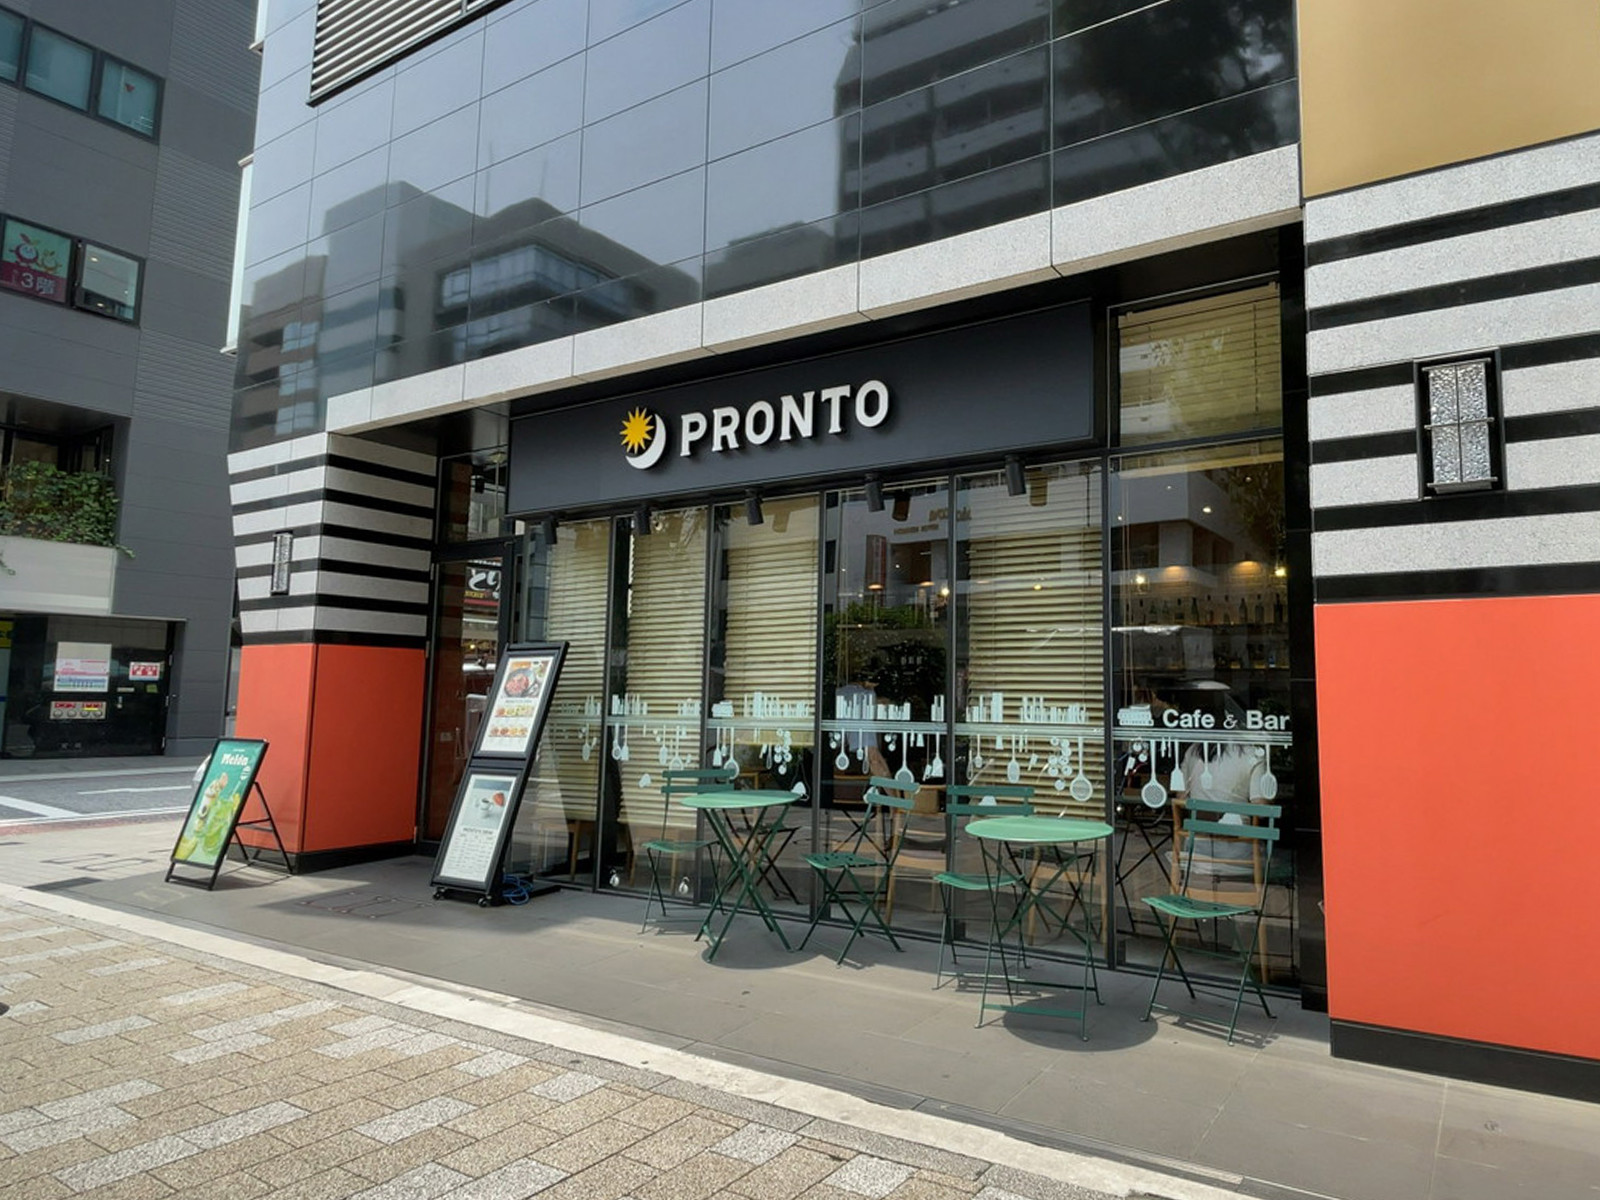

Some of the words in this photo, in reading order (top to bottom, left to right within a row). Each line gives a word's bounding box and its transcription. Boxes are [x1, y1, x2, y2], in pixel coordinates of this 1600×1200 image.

[680, 380, 889, 457] PRONTO
[1162, 708, 1215, 729] Cafe
[1223, 714, 1238, 729] &
[1246, 709, 1290, 731] Bar
